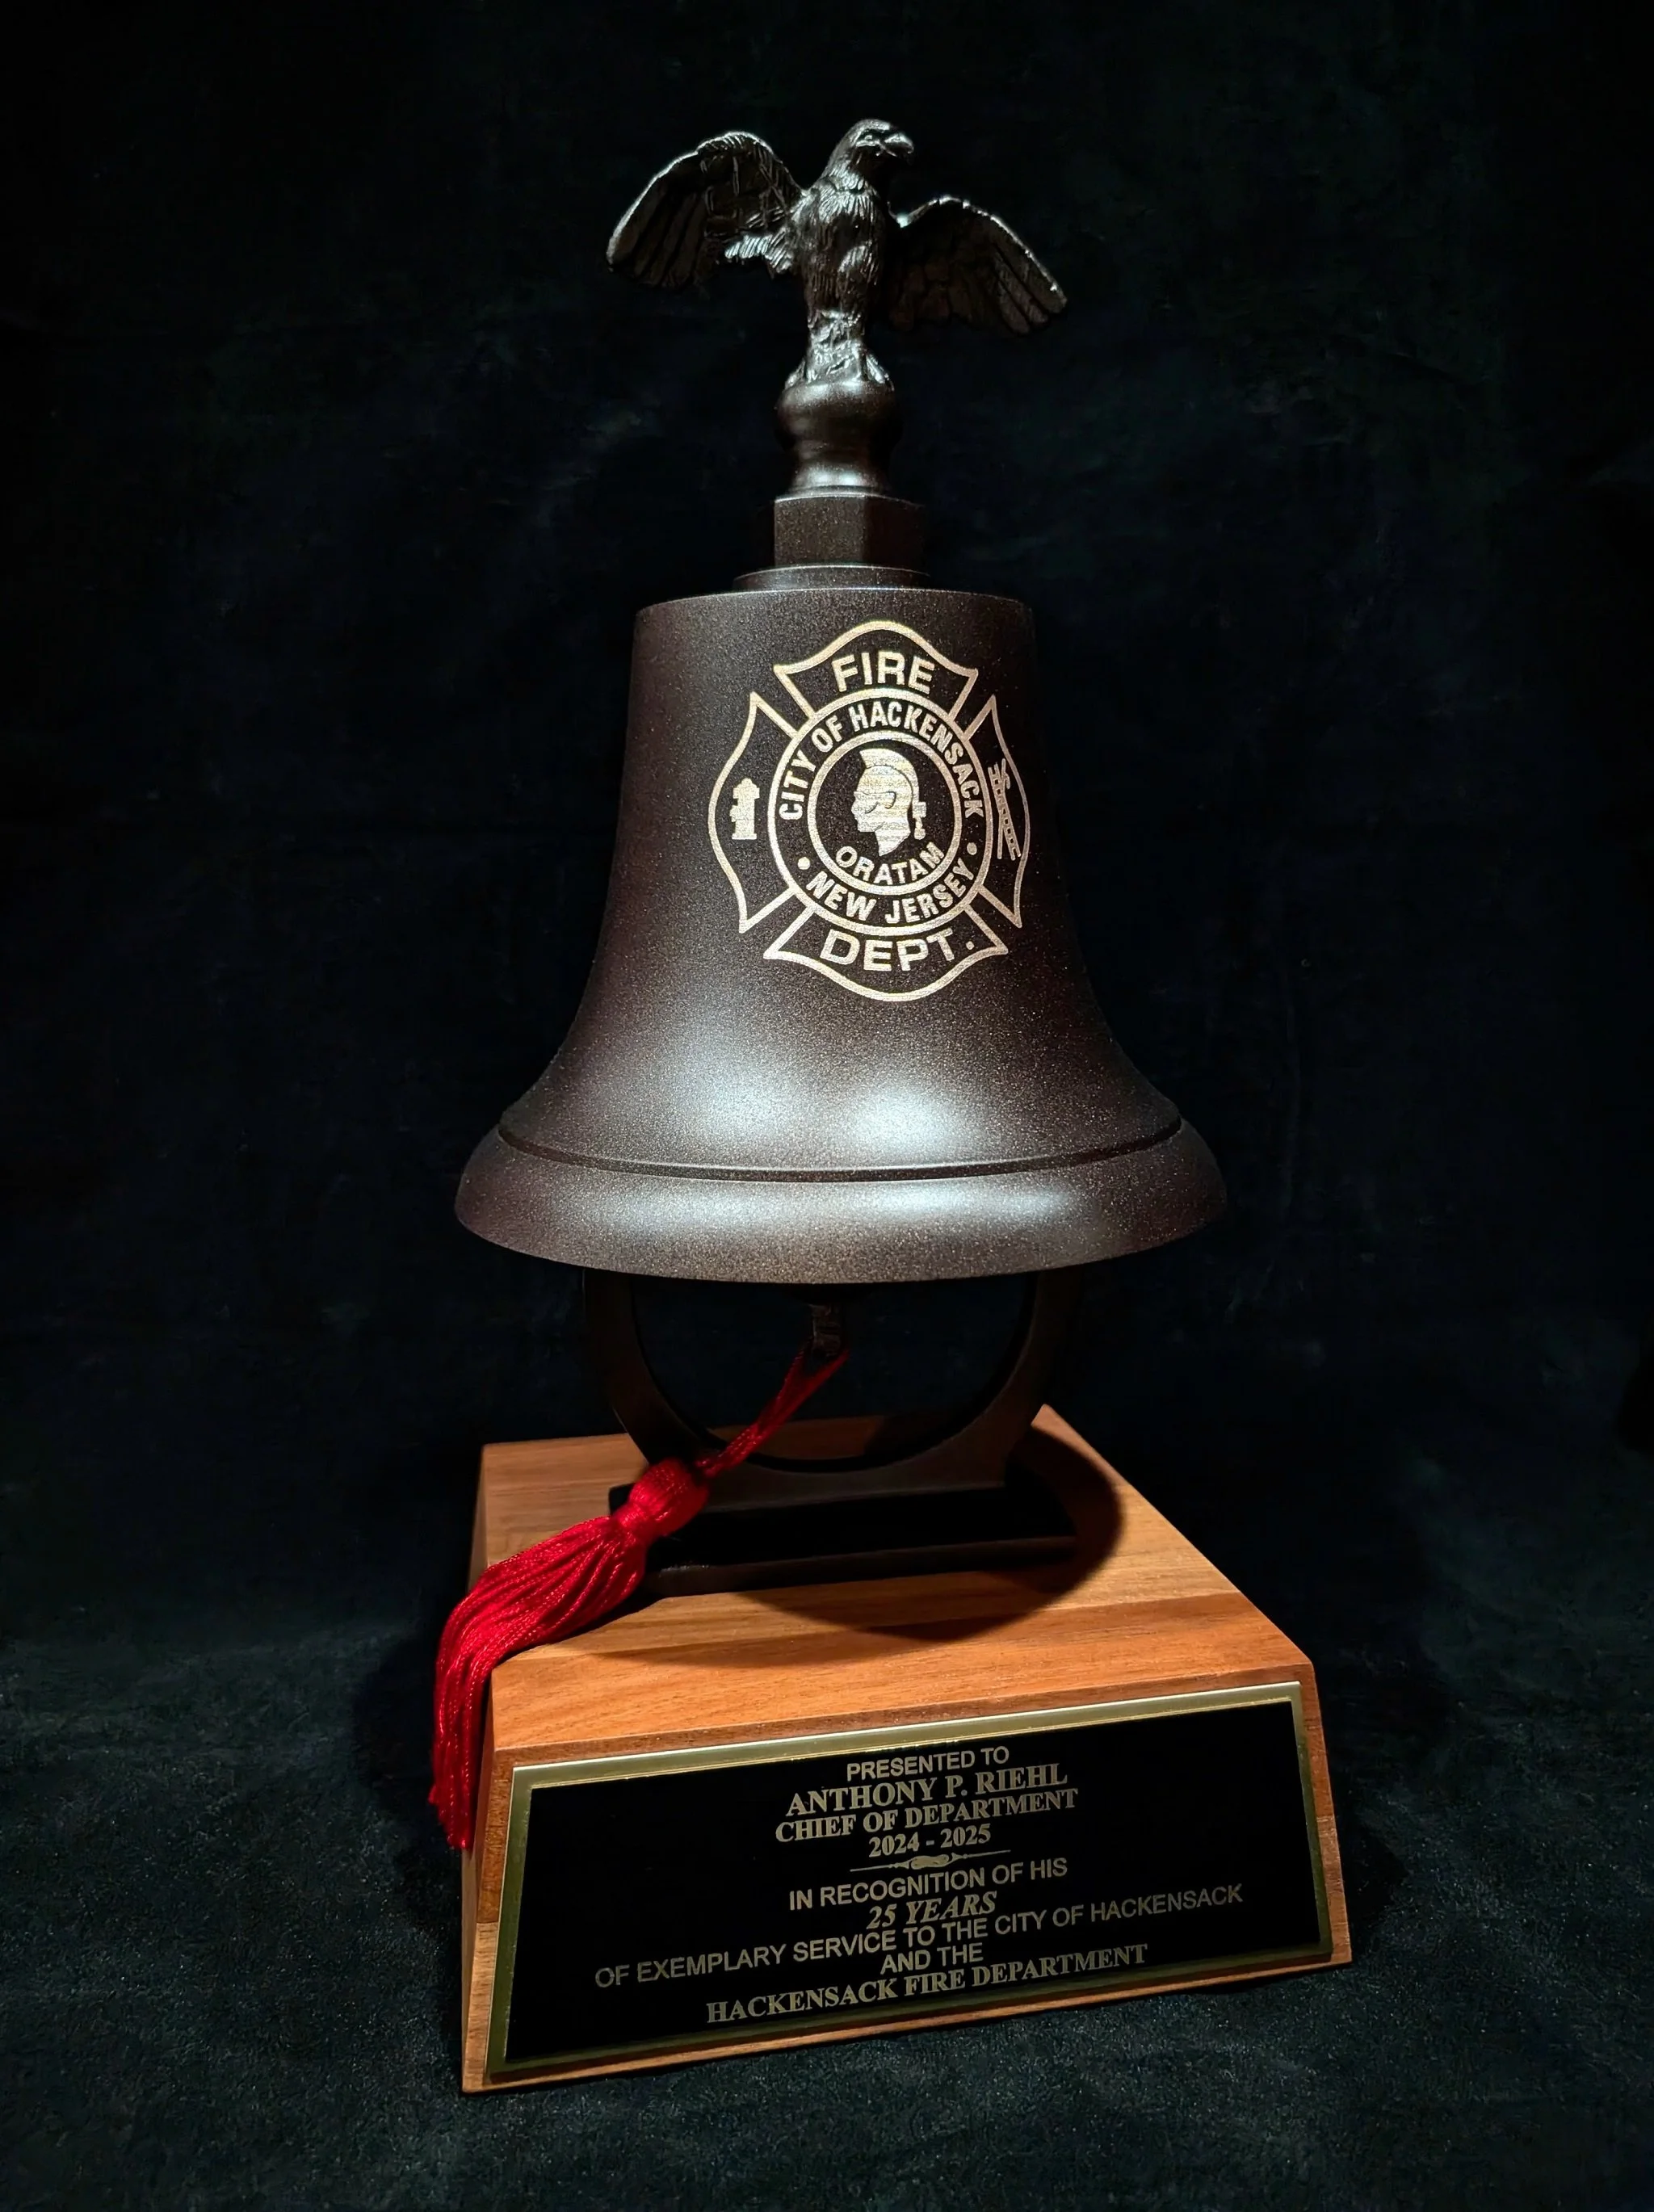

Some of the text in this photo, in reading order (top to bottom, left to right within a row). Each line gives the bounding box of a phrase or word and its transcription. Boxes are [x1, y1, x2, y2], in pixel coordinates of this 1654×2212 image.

[833, 652, 935, 694] FIRE
[779, 701, 984, 820] CITY OF HACKENSACK
[836, 842, 944, 883] ORATAM
[806, 863, 975, 923] NEW JERSEY
[820, 929, 974, 971] DEPT.
[847, 1746, 1010, 1781] PRESENTED TO
[786, 1764, 1068, 1816] ANTHONY P. RIEHL
[775, 1788, 1078, 1842] CHIEF OF DEPARTMENT
[869, 1832, 920, 1857] 2024
[940, 1824, 991, 1848] 2025
[790, 1857, 1068, 1911] IN RECOGNITION OF HIS
[866, 1891, 997, 1929] 25 YEARS
[595, 1883, 1243, 1987] OF EXEMPLARY SERVICE TO THE CITY OF HACKENSACK
[880, 1943, 984, 1975] AND THE
[706, 1944, 1148, 2023] HACKENSACK FIRE DEPARTMENT
